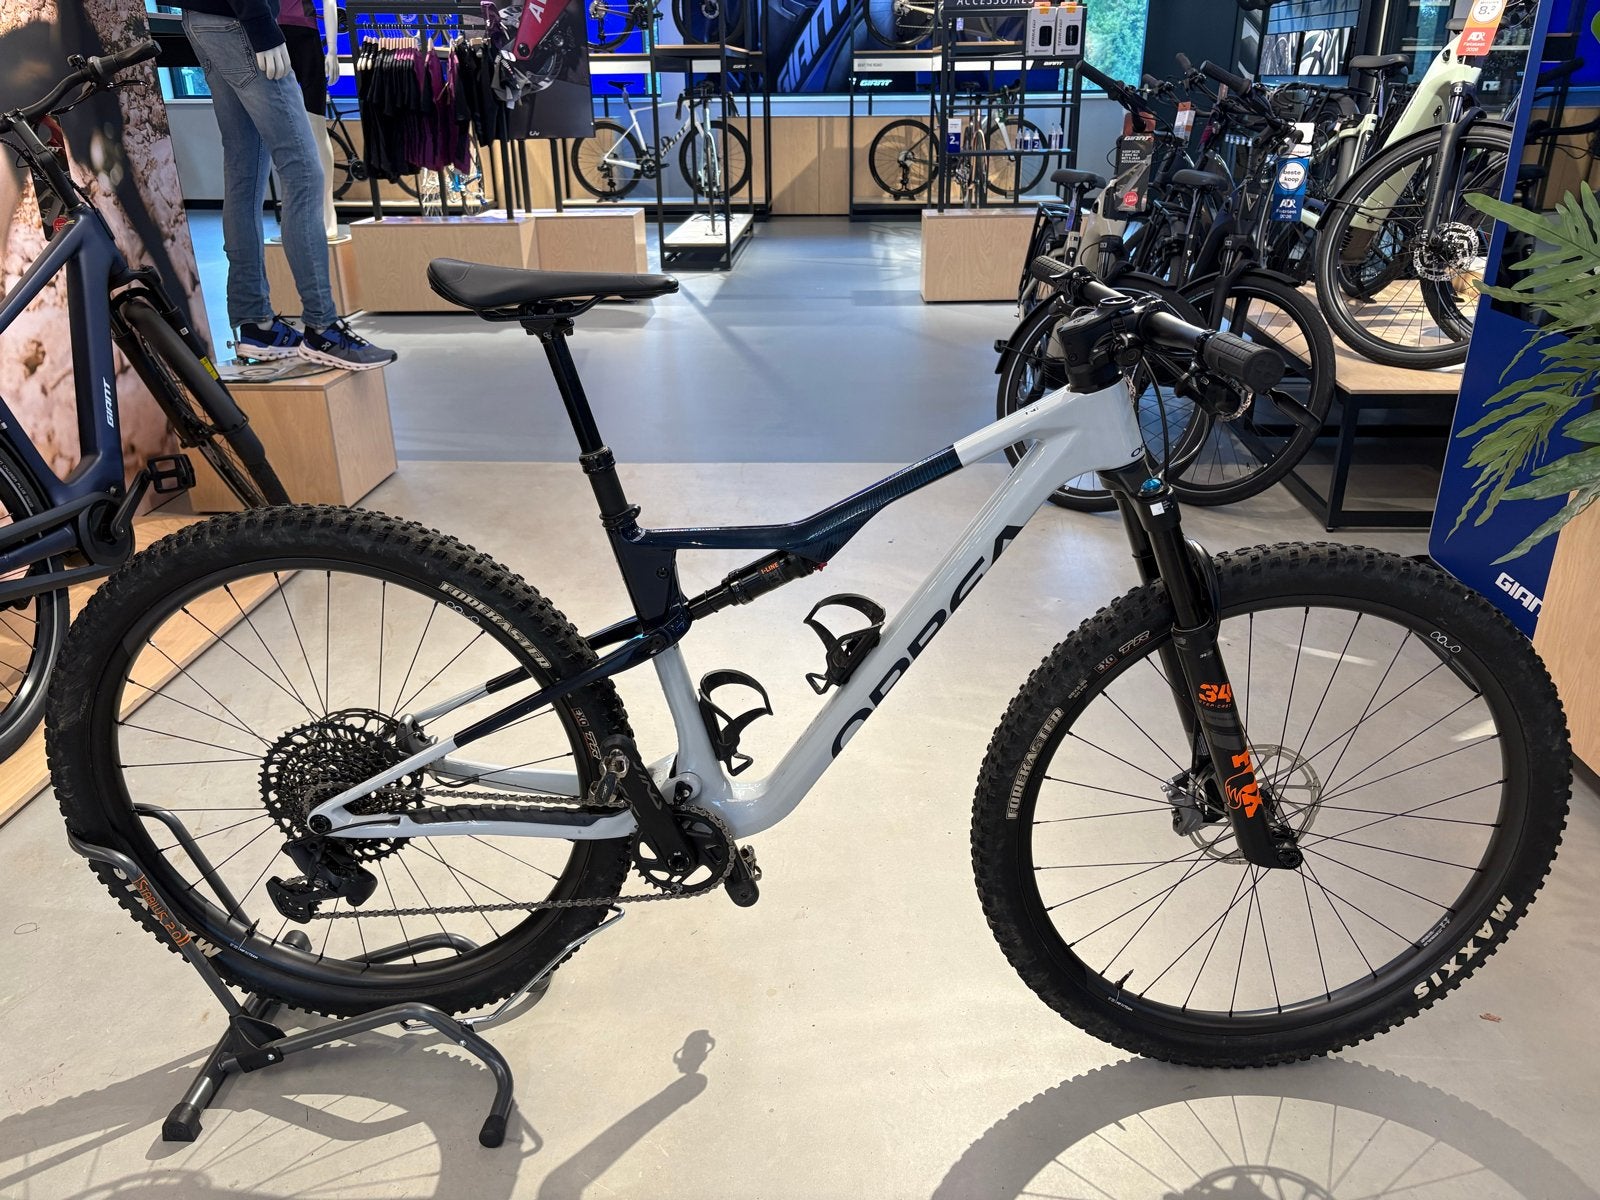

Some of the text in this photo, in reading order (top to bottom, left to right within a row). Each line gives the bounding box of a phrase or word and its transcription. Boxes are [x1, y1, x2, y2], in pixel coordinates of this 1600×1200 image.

[859, 79, 893, 87] GIANT
[1283, 168, 1302, 176] beste
[1284, 175, 1300, 184] koop
[102, 376, 115, 428] GIANT
[1494, 571, 1544, 618] GIAN
[440, 581, 552, 669] FOREKASTER
[1198, 683, 1232, 703] 34
[1005, 706, 1065, 820] FOREKASTER
[1413, 894, 1514, 1000] MAXXIS
